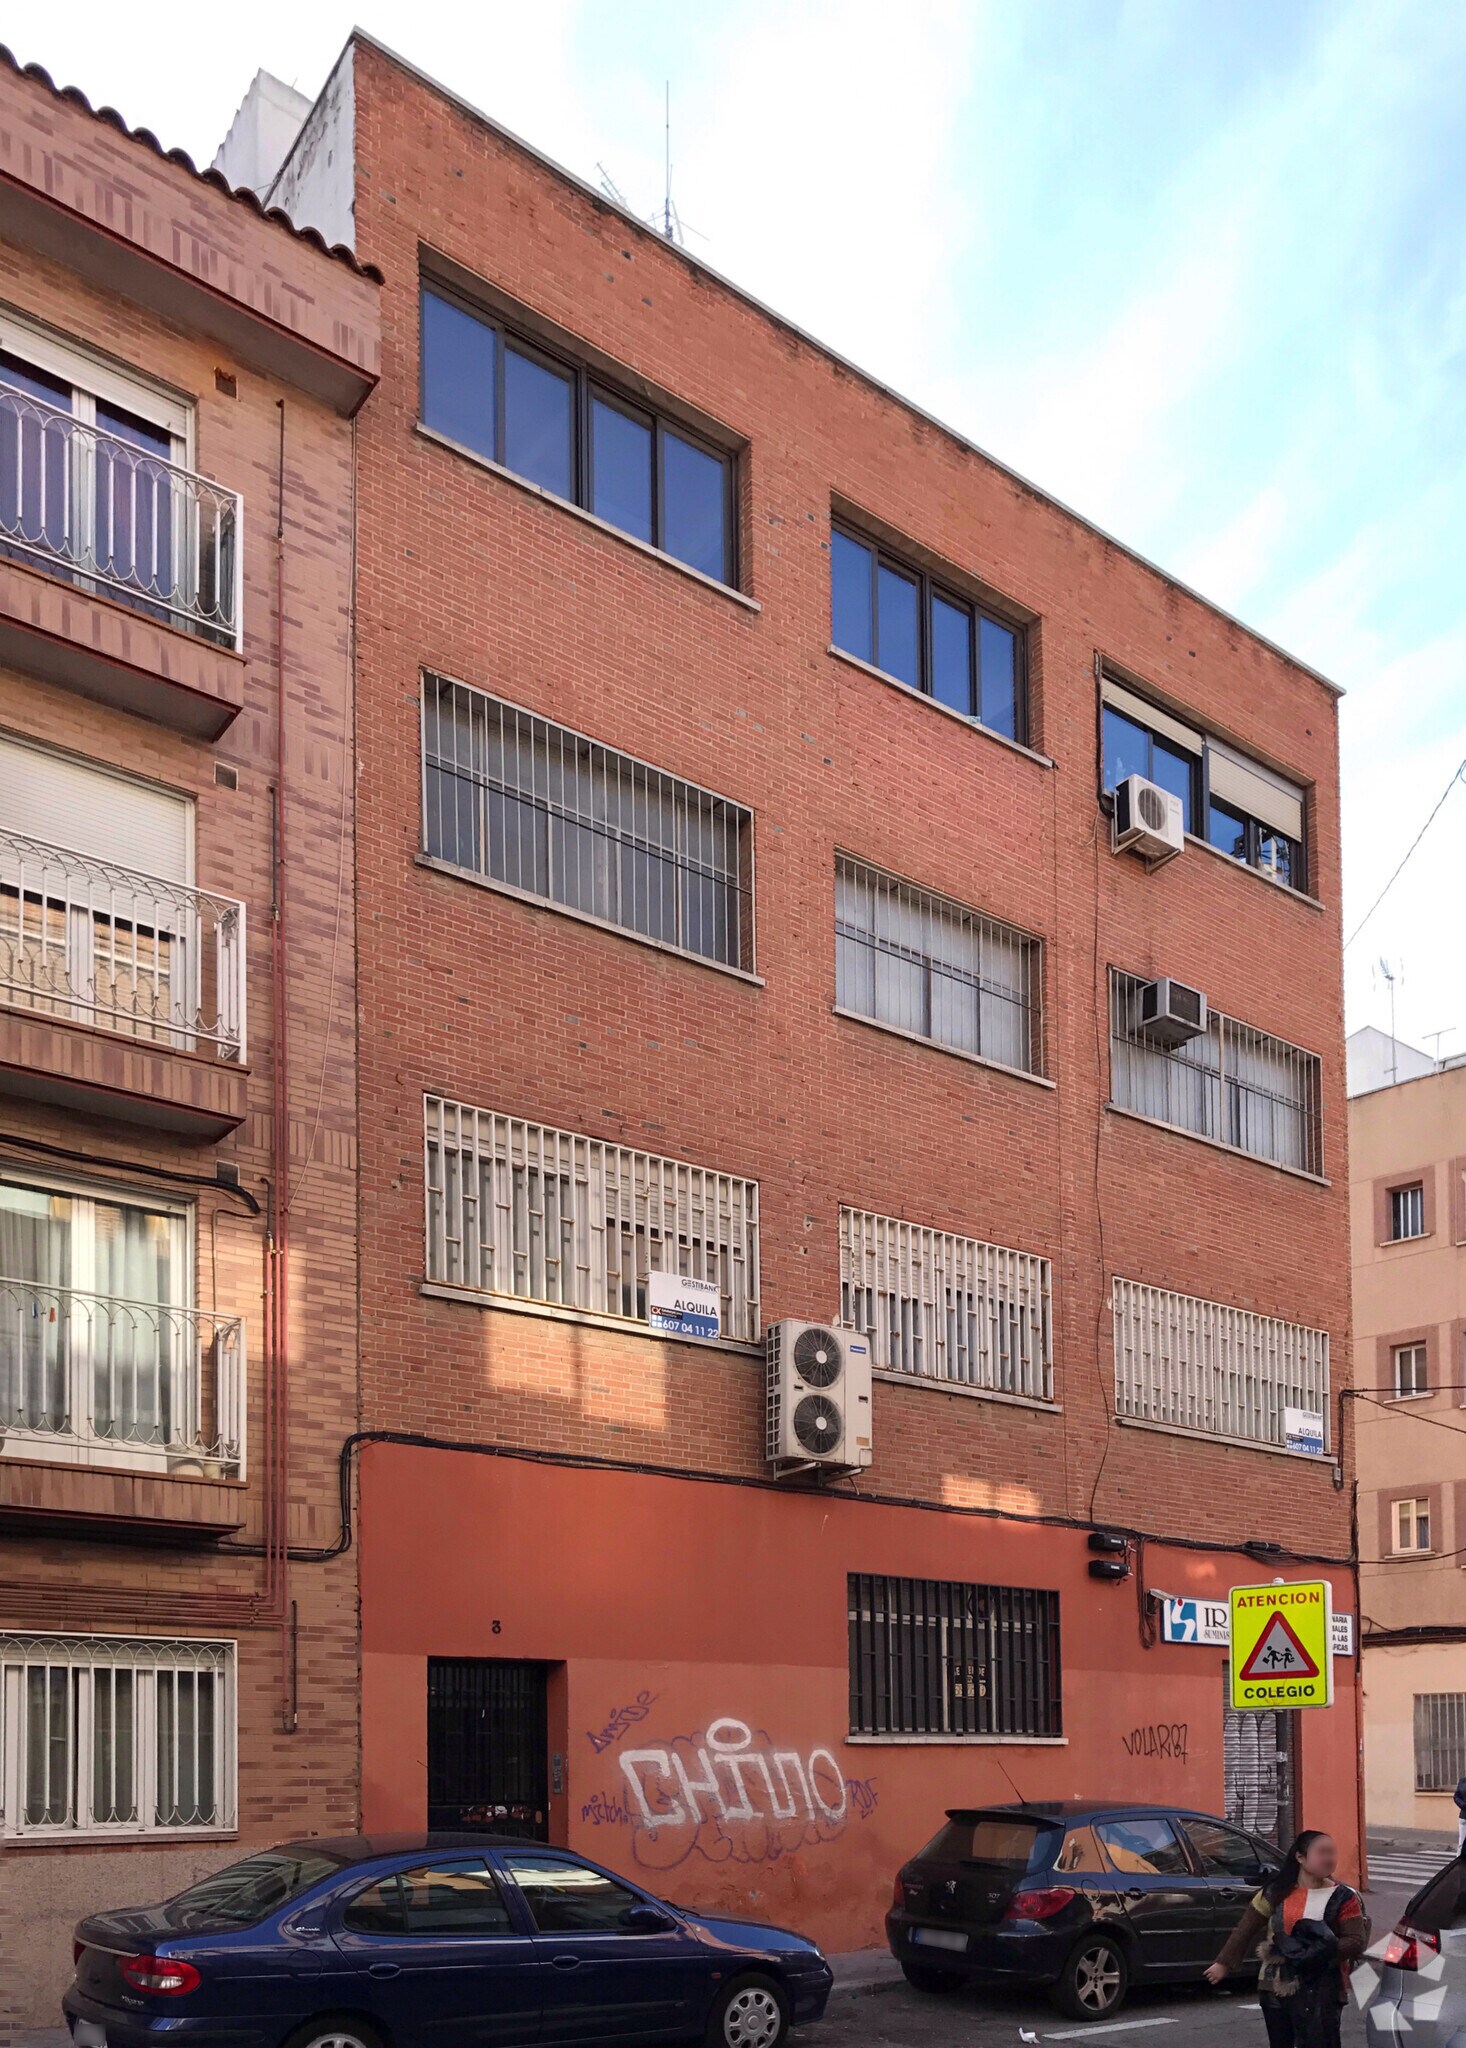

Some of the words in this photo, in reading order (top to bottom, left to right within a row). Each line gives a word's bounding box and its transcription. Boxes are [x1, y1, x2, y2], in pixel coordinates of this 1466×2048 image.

[681, 1278, 718, 1293] GESTIBANK
[674, 1299, 718, 1317] ALQUILA
[662, 1319, 680, 1331] 607
[681, 1322, 693, 1334] 04
[695, 1325, 705, 1336] 11
[707, 1327, 719, 1338] 22
[1298, 1427, 1322, 1438] ALQUILA
[1236, 1591, 1321, 1608] ATENCION
[491, 1619, 502, 1635] 3
[1244, 1685, 1315, 1700] COLEGIO
